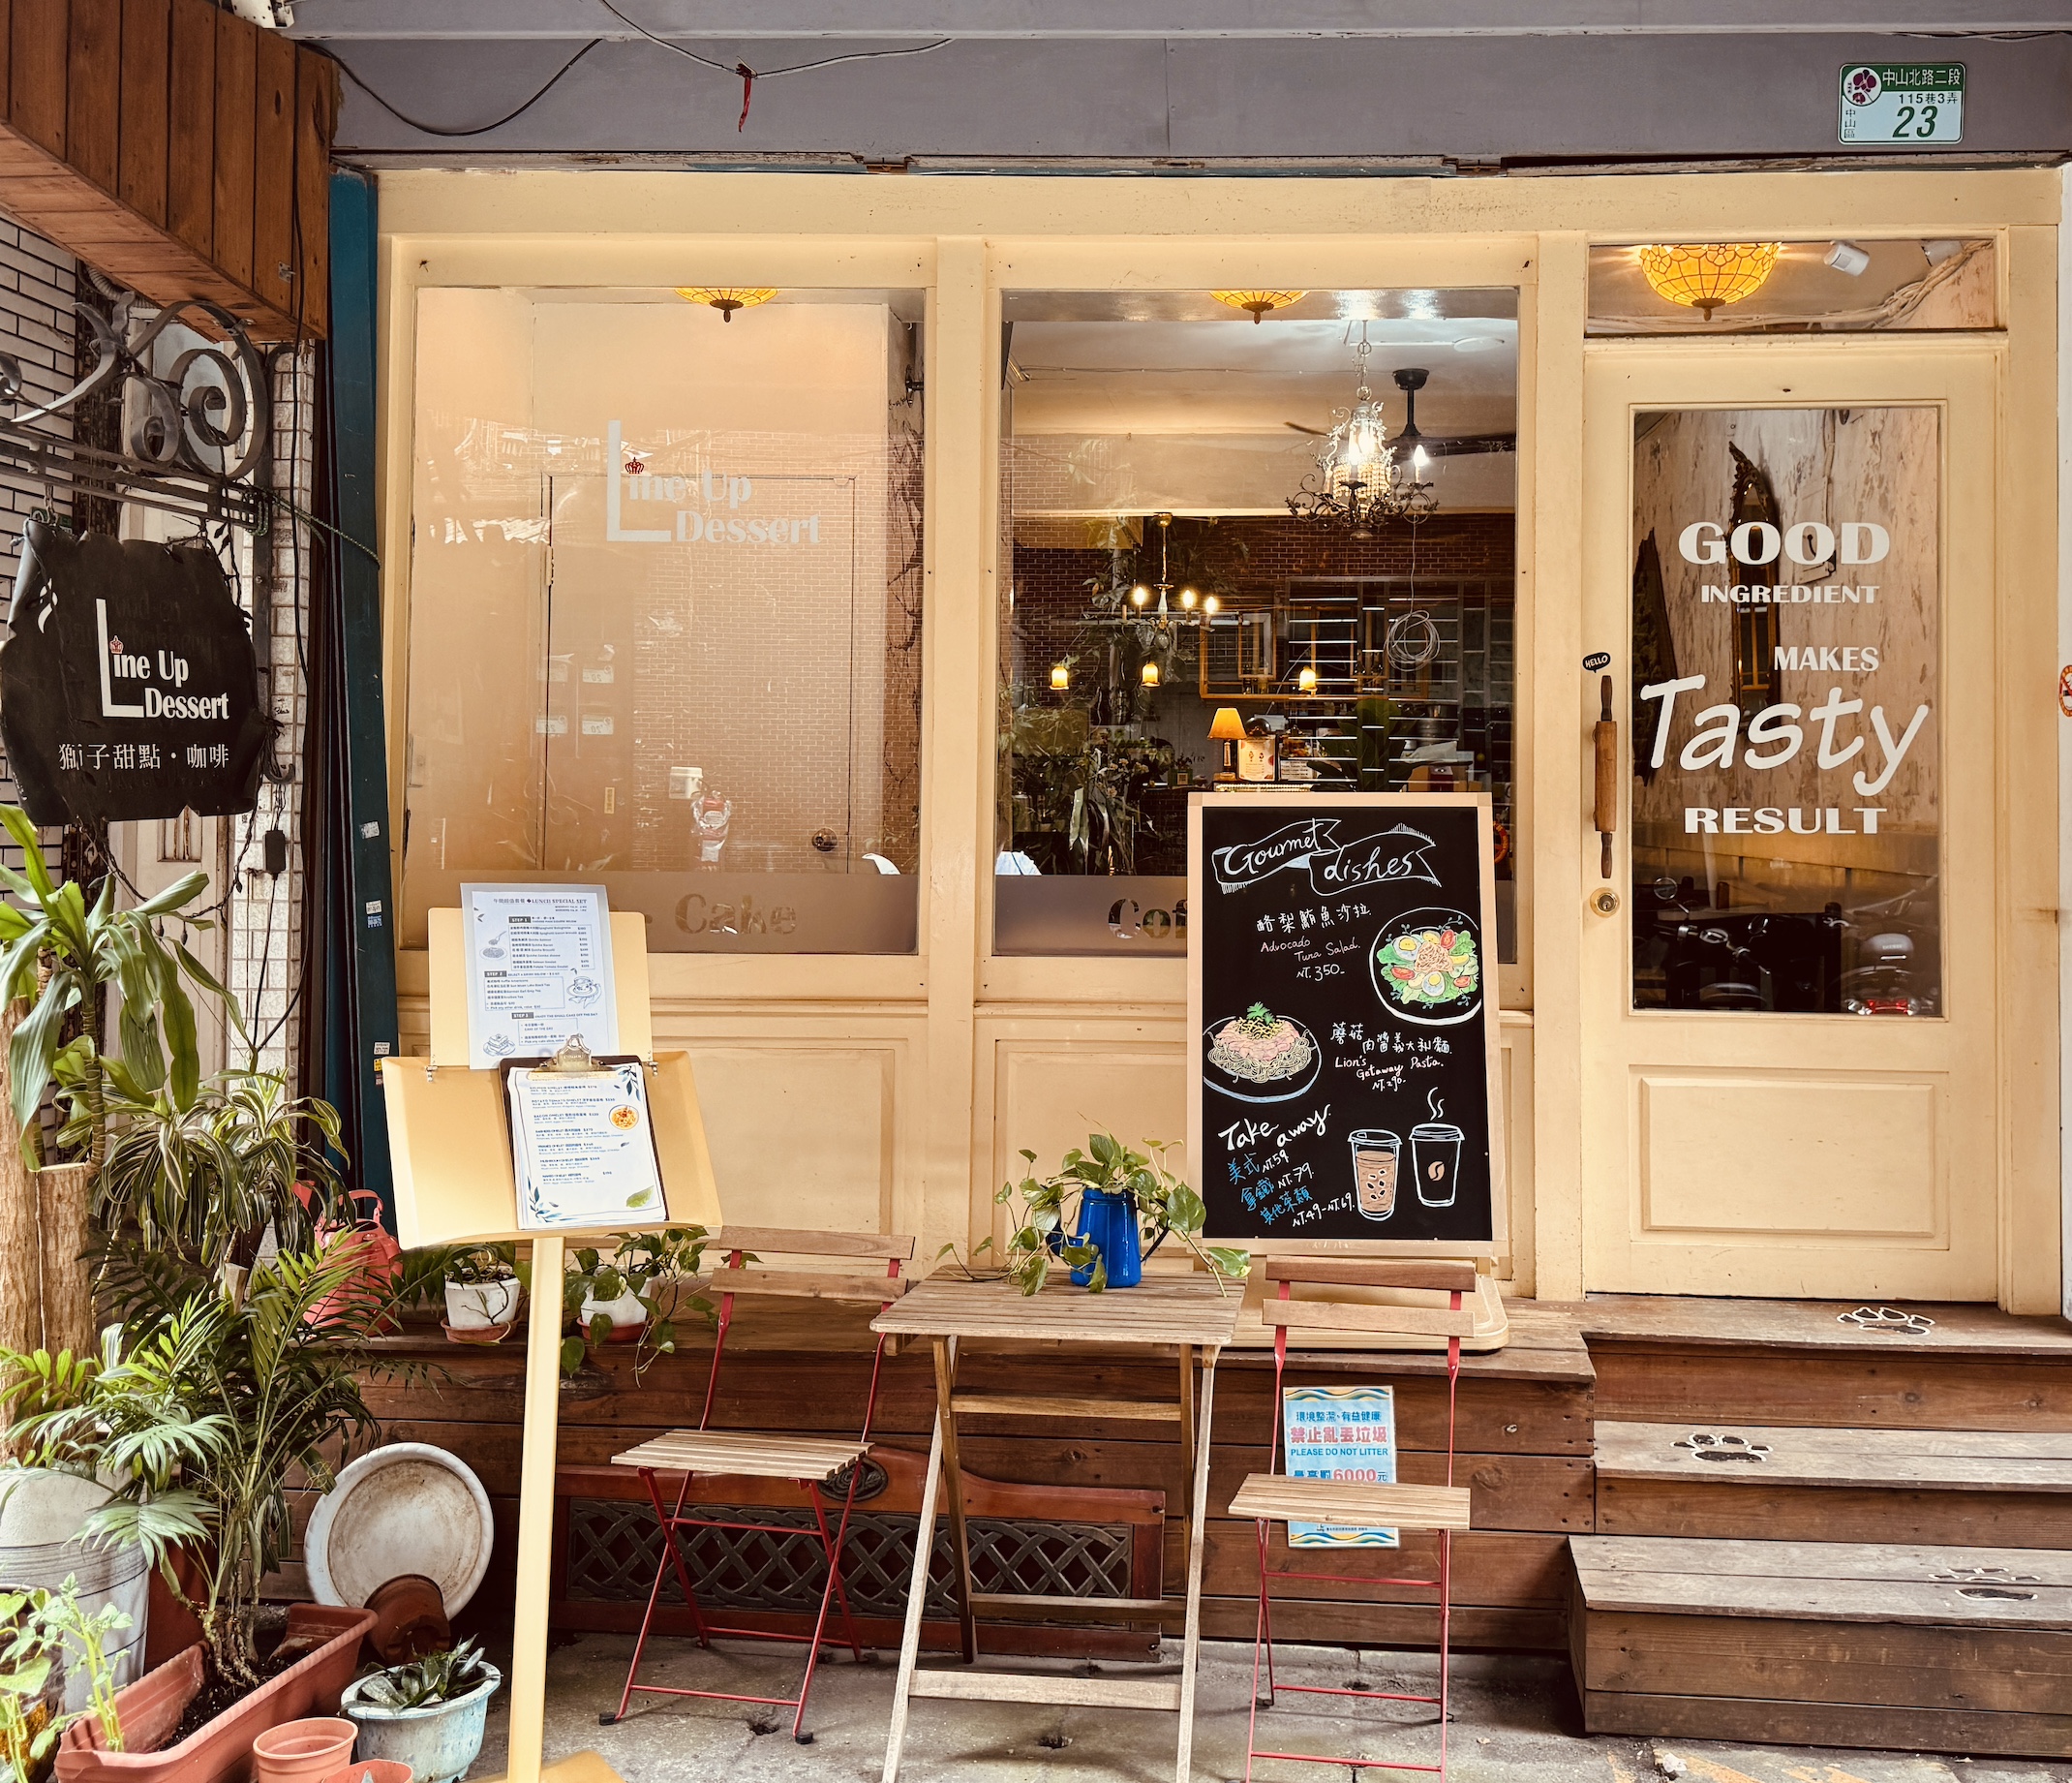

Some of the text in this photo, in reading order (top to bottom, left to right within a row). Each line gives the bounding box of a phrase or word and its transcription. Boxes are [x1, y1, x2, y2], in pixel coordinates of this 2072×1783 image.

[1882, 68, 1962, 86] 中山北路二段
[1899, 93, 1959, 105] 115巷3弄
[1844, 108, 1856, 138] 中山區
[1892, 106, 1937, 138] 23
[607, 420, 752, 542] Line Up
[677, 510, 821, 543] Dessert
[1678, 521, 1890, 566] GOOD
[1701, 585, 1879, 603] INGREDIENT
[158, 650, 190, 688] Up
[1585, 655, 1608, 668] HELLO
[1774, 646, 1879, 671] MAKES
[144, 687, 229, 720] Dessert
[1640, 674, 1929, 797] Tasty
[1685, 808, 1887, 834] RESULT
[1224, 818, 1325, 876] Gourmet
[1324, 846, 1415, 881] dishes
[675, 893, 797, 935] Cake
[1335, 1055, 1367, 1068] Lion's
[1356, 1064, 1404, 1081] Getaway
[1217, 1118, 1280, 1151] Take
[1227, 1152, 1261, 1185] 美式
[1291, 1426, 1387, 1444] 禁止亂丟垃圾
